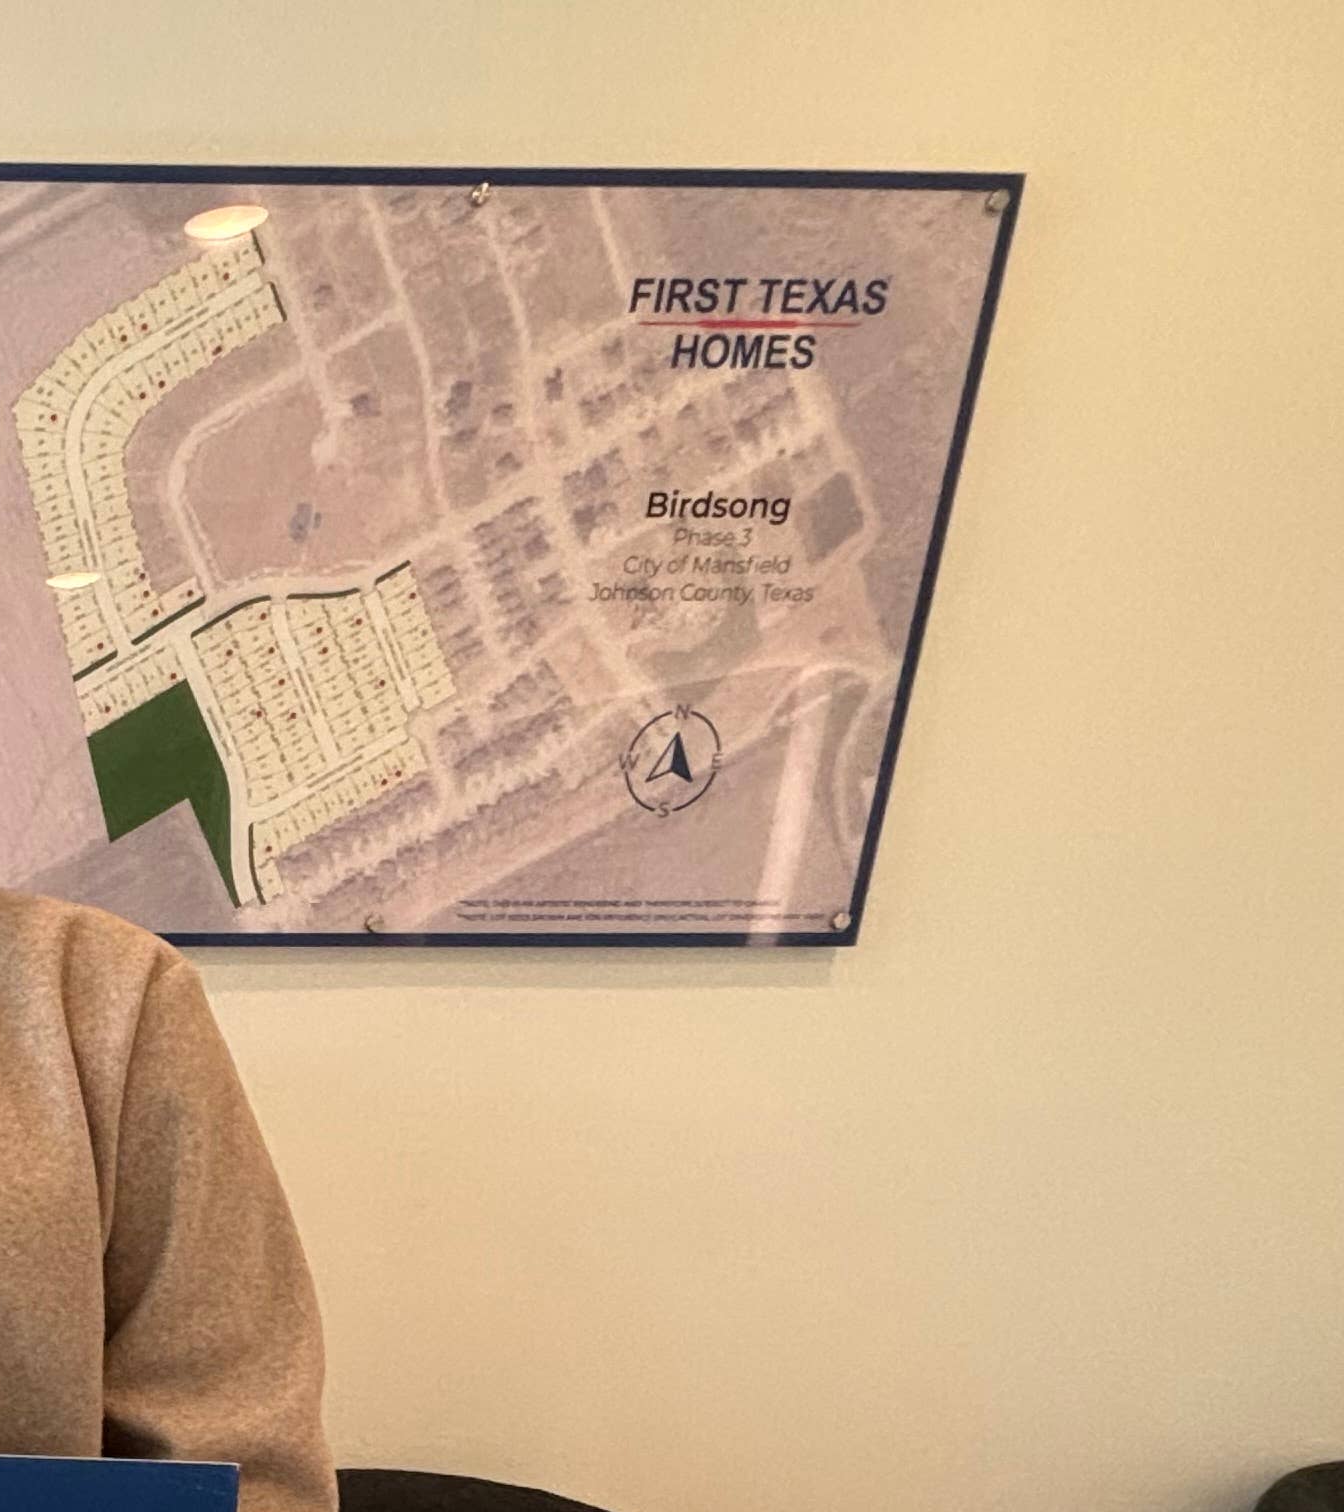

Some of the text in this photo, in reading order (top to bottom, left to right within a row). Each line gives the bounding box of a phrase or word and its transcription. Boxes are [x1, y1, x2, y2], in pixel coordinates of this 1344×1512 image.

[628, 278, 889, 315] FIRST TEXAS
[670, 333, 817, 369] HOMES
[645, 489, 792, 526] Birdsong
[673, 528, 753, 547] Phase 3
[622, 556, 792, 577] City of Mansfield
[588, 582, 674, 602] Johnson
[761, 583, 814, 603] Texas
